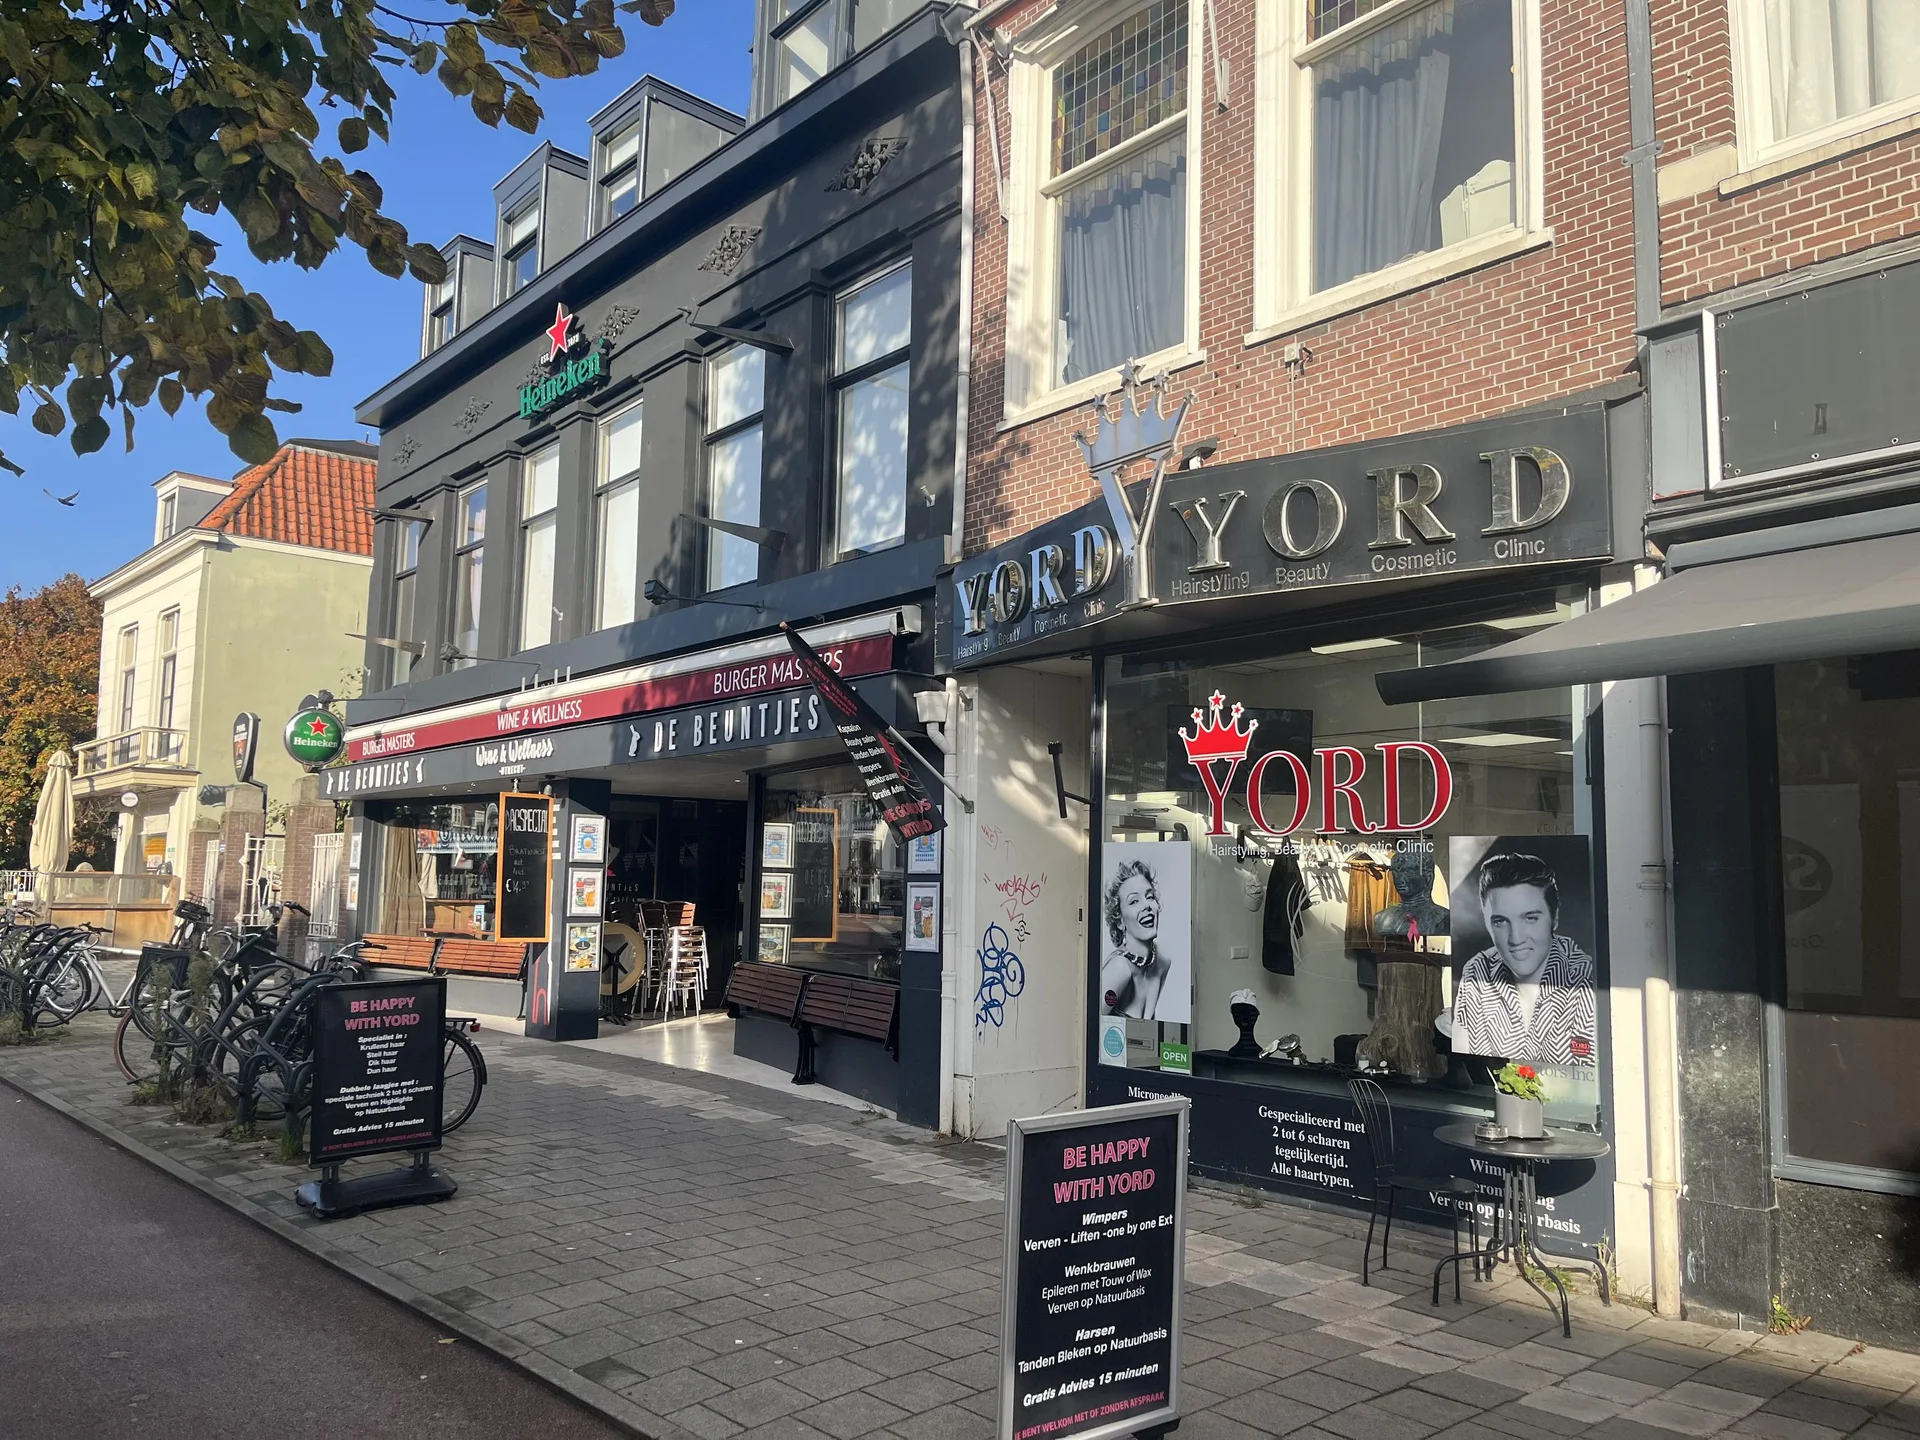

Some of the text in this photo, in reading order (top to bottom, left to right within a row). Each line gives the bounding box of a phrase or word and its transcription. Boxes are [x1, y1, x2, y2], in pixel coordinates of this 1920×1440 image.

[519, 351, 600, 419] Heineken
[1169, 445, 1572, 573] YORD
[1171, 538, 1546, 598] Hairstyling Beauty Cosmetic Clinic
[955, 525, 1113, 637] YORD
[1034, 613, 1068, 634] Cosmetic
[1083, 599, 1106, 618] Clinic
[713, 664, 767, 695] BURGER
[497, 699, 582, 731] WINE & WELLNESS
[654, 718, 677, 753] DE
[693, 694, 819, 747] BEUNTJES
[837, 723, 862, 735] Kapsalon
[844, 734, 877, 748] Beauty salon
[293, 736, 338, 748] Heineken
[362, 732, 415, 756] BURGER MASTERS
[475, 737, 554, 767] Wine & Wellness
[851, 749, 869, 761] Tanden
[337, 761, 409, 792] DE BEUNTJES
[1188, 740, 1453, 837] YORD
[872, 787, 891, 801] Gratis
[1209, 842, 1271, 859] Hairstyling,
[1396, 838, 1434, 854] Clinic
[350, 997, 416, 1013] BE HAPPY
[344, 1013, 420, 1031] WITH YORD
[358, 1034, 394, 1044] Specialist
[360, 1042, 389, 1051] Krullend
[381, 1058, 397, 1066] haar
[1163, 1051, 1187, 1063] OPEN
[325, 1095, 355, 1104] speciale
[356, 1092, 385, 1100] techniek
[402, 1087, 408, 1095] 6
[408, 1085, 434, 1094] scharen
[340, 1085, 371, 1094] Dubbele
[373, 1082, 399, 1092] laagjes
[400, 1079, 415, 1087] met
[345, 1102, 369, 1110] Verven
[380, 1096, 414, 1106] Highlights
[365, 1105, 406, 1115] Natuurbasis
[333, 1126, 356, 1136] Gratis
[357, 1123, 383, 1133] Advies
[395, 1117, 425, 1127] minuten
[1258, 1105, 1366, 1133] Gespecialiceerd met
[1272, 1125, 1351, 1150] 2 tot 6 scharen
[1063, 1136, 1151, 1170] BE HAPPY
[1275, 1144, 1348, 1169] tegelijkertijd.
[1053, 1168, 1156, 1204] WITH YORD
[1270, 1161, 1354, 1188] Alle haartypen.
[1082, 1209, 1129, 1226] Wimpers
[1476, 1203, 1494, 1219] op
[1024, 1236, 1061, 1251] Verven
[1071, 1230, 1100, 1244] Liften
[1127, 1223, 1138, 1235] by
[1140, 1219, 1156, 1231] one
[1158, 1214, 1174, 1227] Ext
[1064, 1256, 1136, 1277] Wenkbrauwen
[1042, 1268, 1152, 1301] Epileren met Touw of Wax
[1047, 1285, 1146, 1314] Verven op Natuurbasis
[1075, 1325, 1116, 1342] Harsen
[1018, 1327, 1168, 1374] Tanden Bleken op Natuurbasis
[1023, 1362, 1159, 1407] Gratis Advies 15 minuten
[1022, 1424, 1041, 1439] BENT
[1041, 1415, 1074, 1433] WELKOM
[1074, 1411, 1089, 1424] MET
[1090, 1408, 1100, 1419] OF
[1100, 1399, 1130, 1416] ZONDER
[1129, 1390, 1165, 1407] AFSPRAAK
